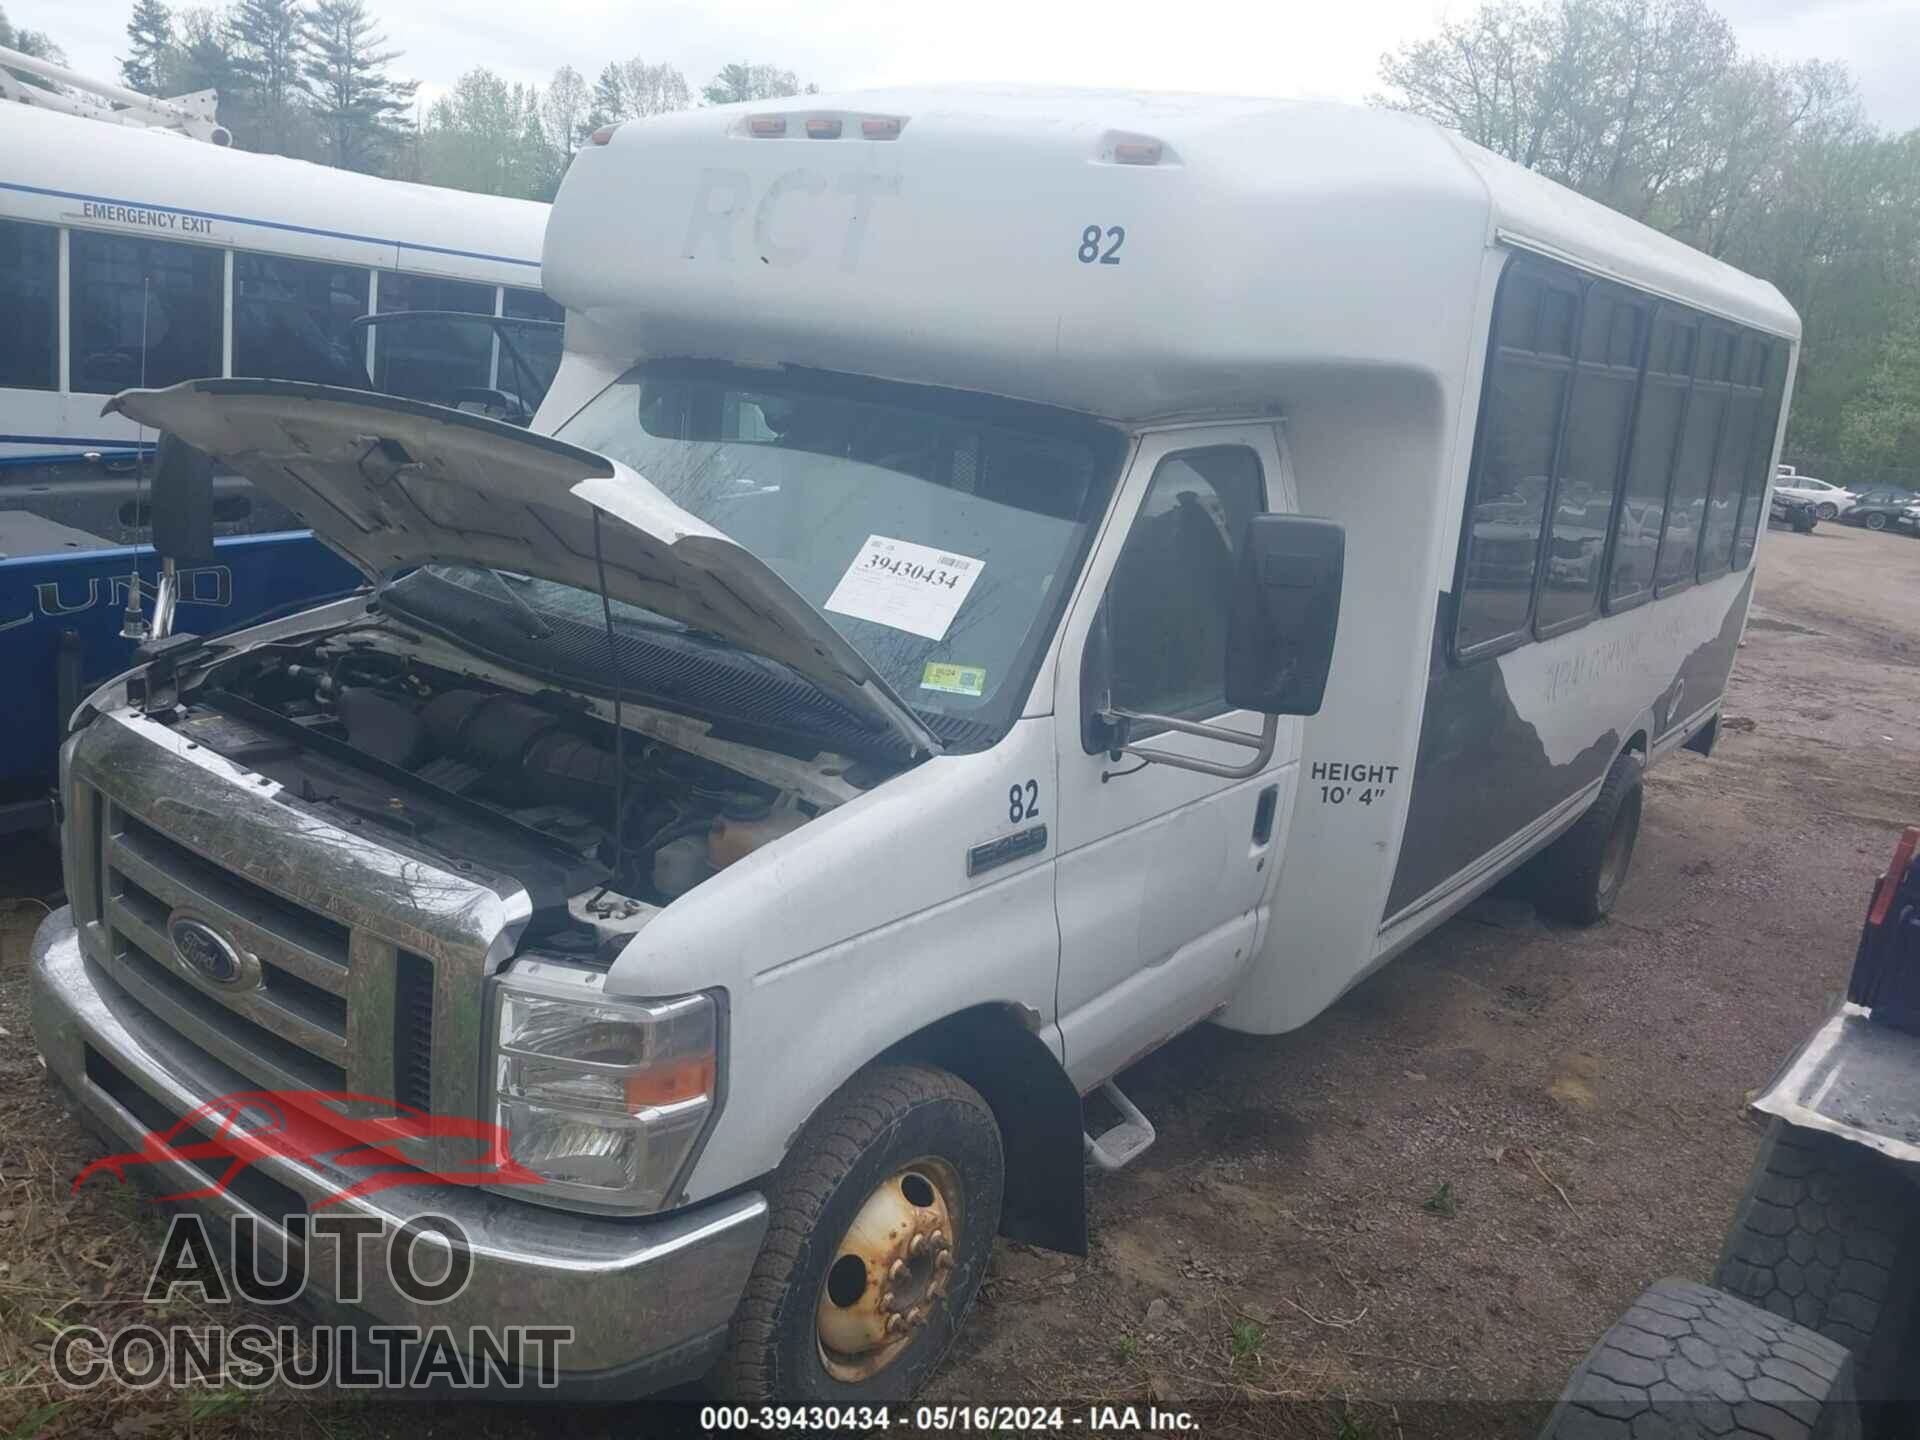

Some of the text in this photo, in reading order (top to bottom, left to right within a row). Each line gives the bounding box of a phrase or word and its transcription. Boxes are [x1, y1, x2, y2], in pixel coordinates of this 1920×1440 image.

[82, 202, 213, 233] EMERGENCY EXIT
[680, 167, 903, 273] RCT
[1078, 225, 1125, 265] 82
[864, 554, 959, 589] 39430434
[1312, 762, 1399, 784] HEIGHT
[1009, 779, 1040, 824] 82
[1321, 786, 1385, 806] 10' 4"
[183, 930, 220, 973] Ford
